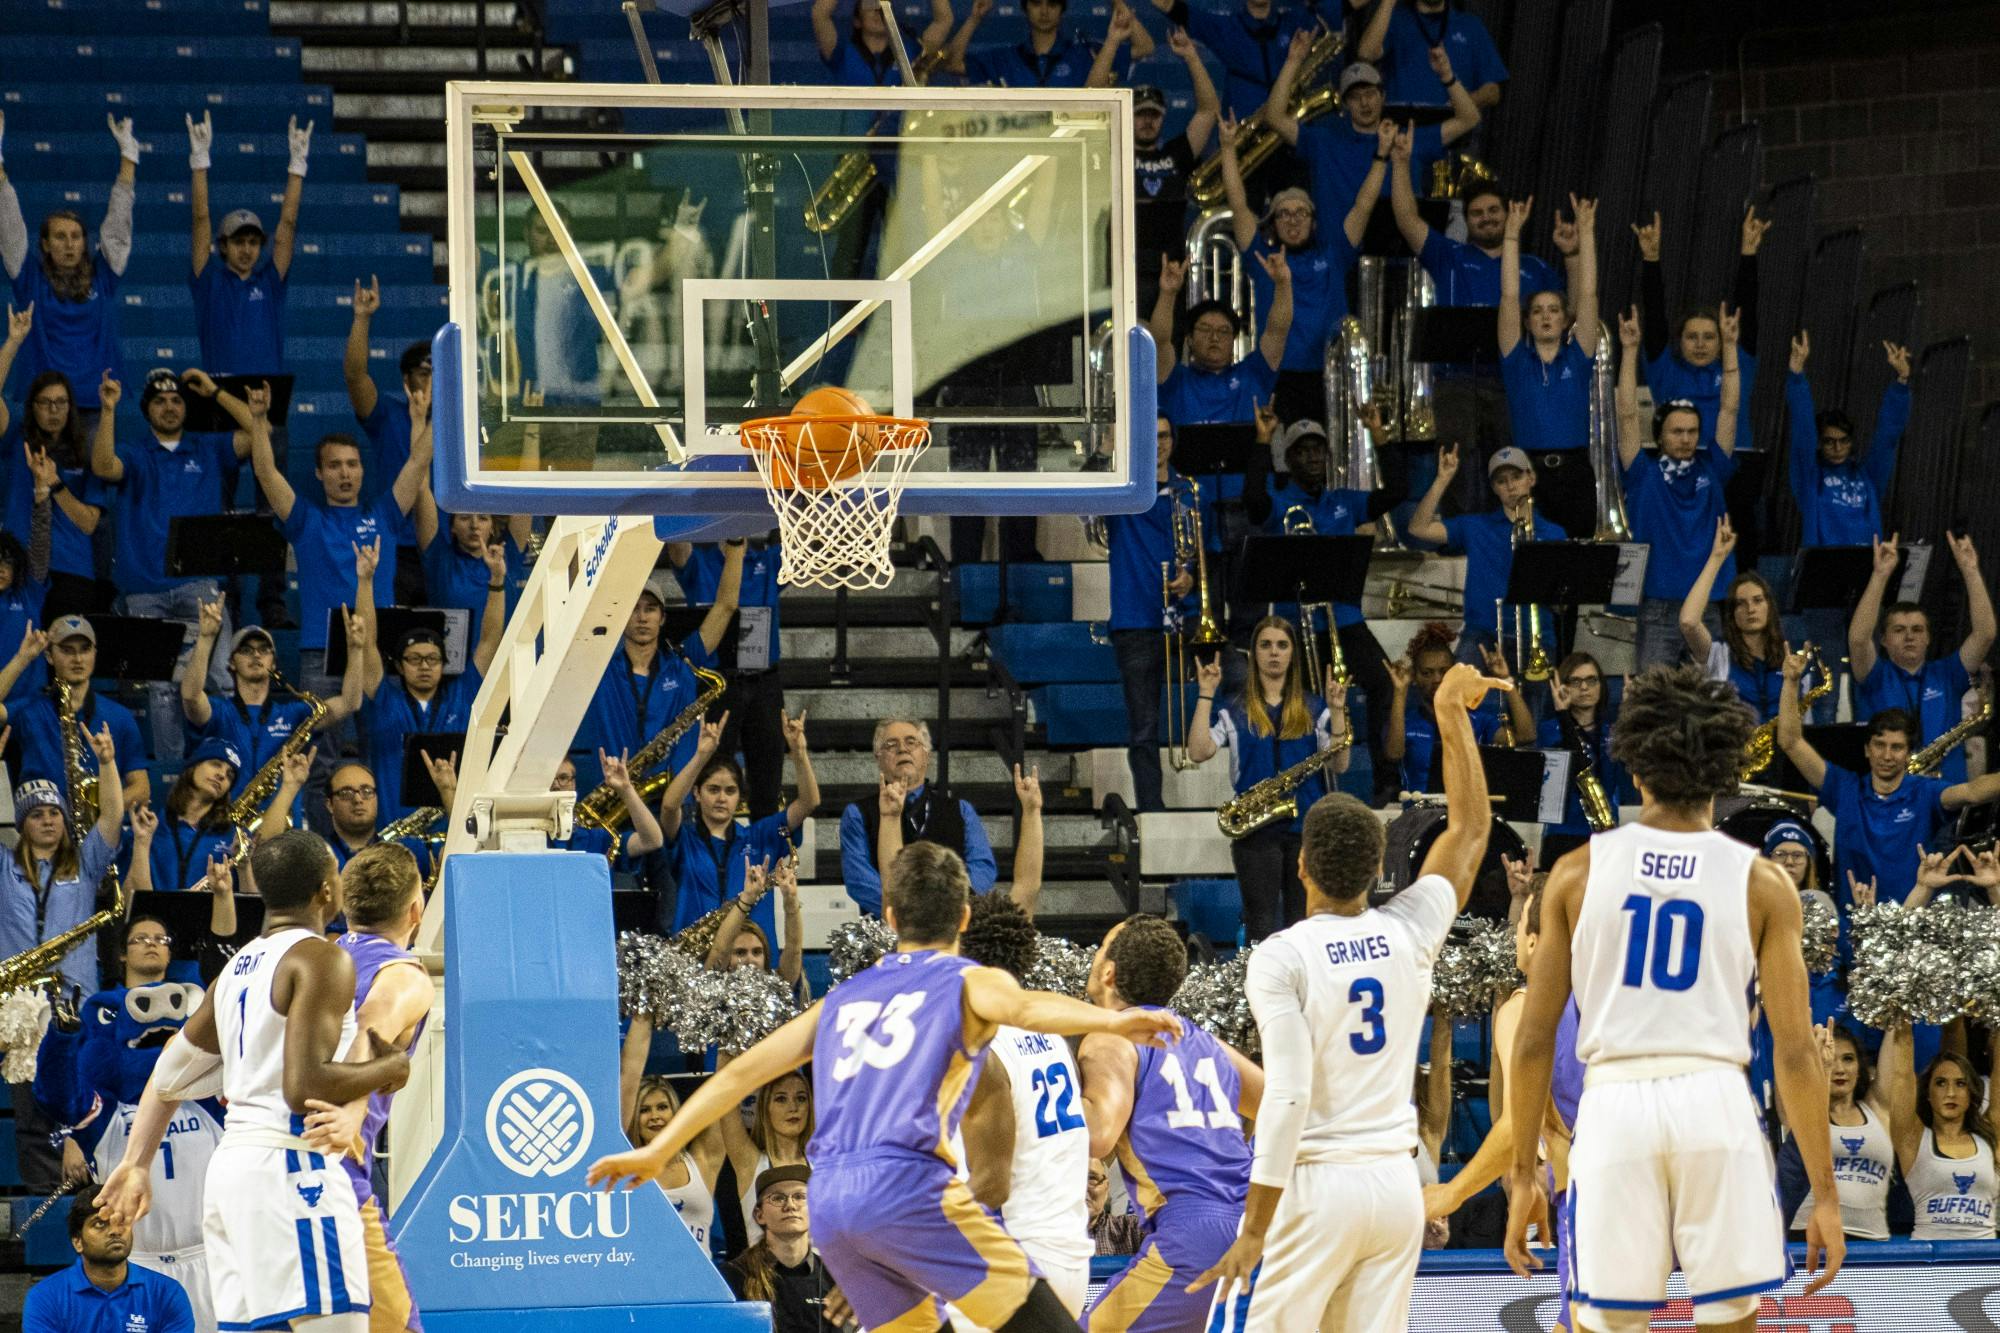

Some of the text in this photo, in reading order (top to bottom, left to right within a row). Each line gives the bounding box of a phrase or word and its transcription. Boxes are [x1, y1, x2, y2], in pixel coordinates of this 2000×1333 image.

[1640, 851, 1697, 880] SEGU
[1326, 935, 1390, 965] GRAVES
[1621, 893, 1704, 992] 10
[238, 986, 249, 1059] 1
[832, 990, 927, 1083] 33
[1348, 977, 1386, 1055] 3
[1031, 1062, 1086, 1139] 22
[1159, 1052, 1241, 1130] 11
[158, 1141, 175, 1180] 1
[449, 1189, 634, 1243] SEFCU
[1927, 1197, 1991, 1219] BUFFALO
[450, 1246, 636, 1271] Changing lives every day.
